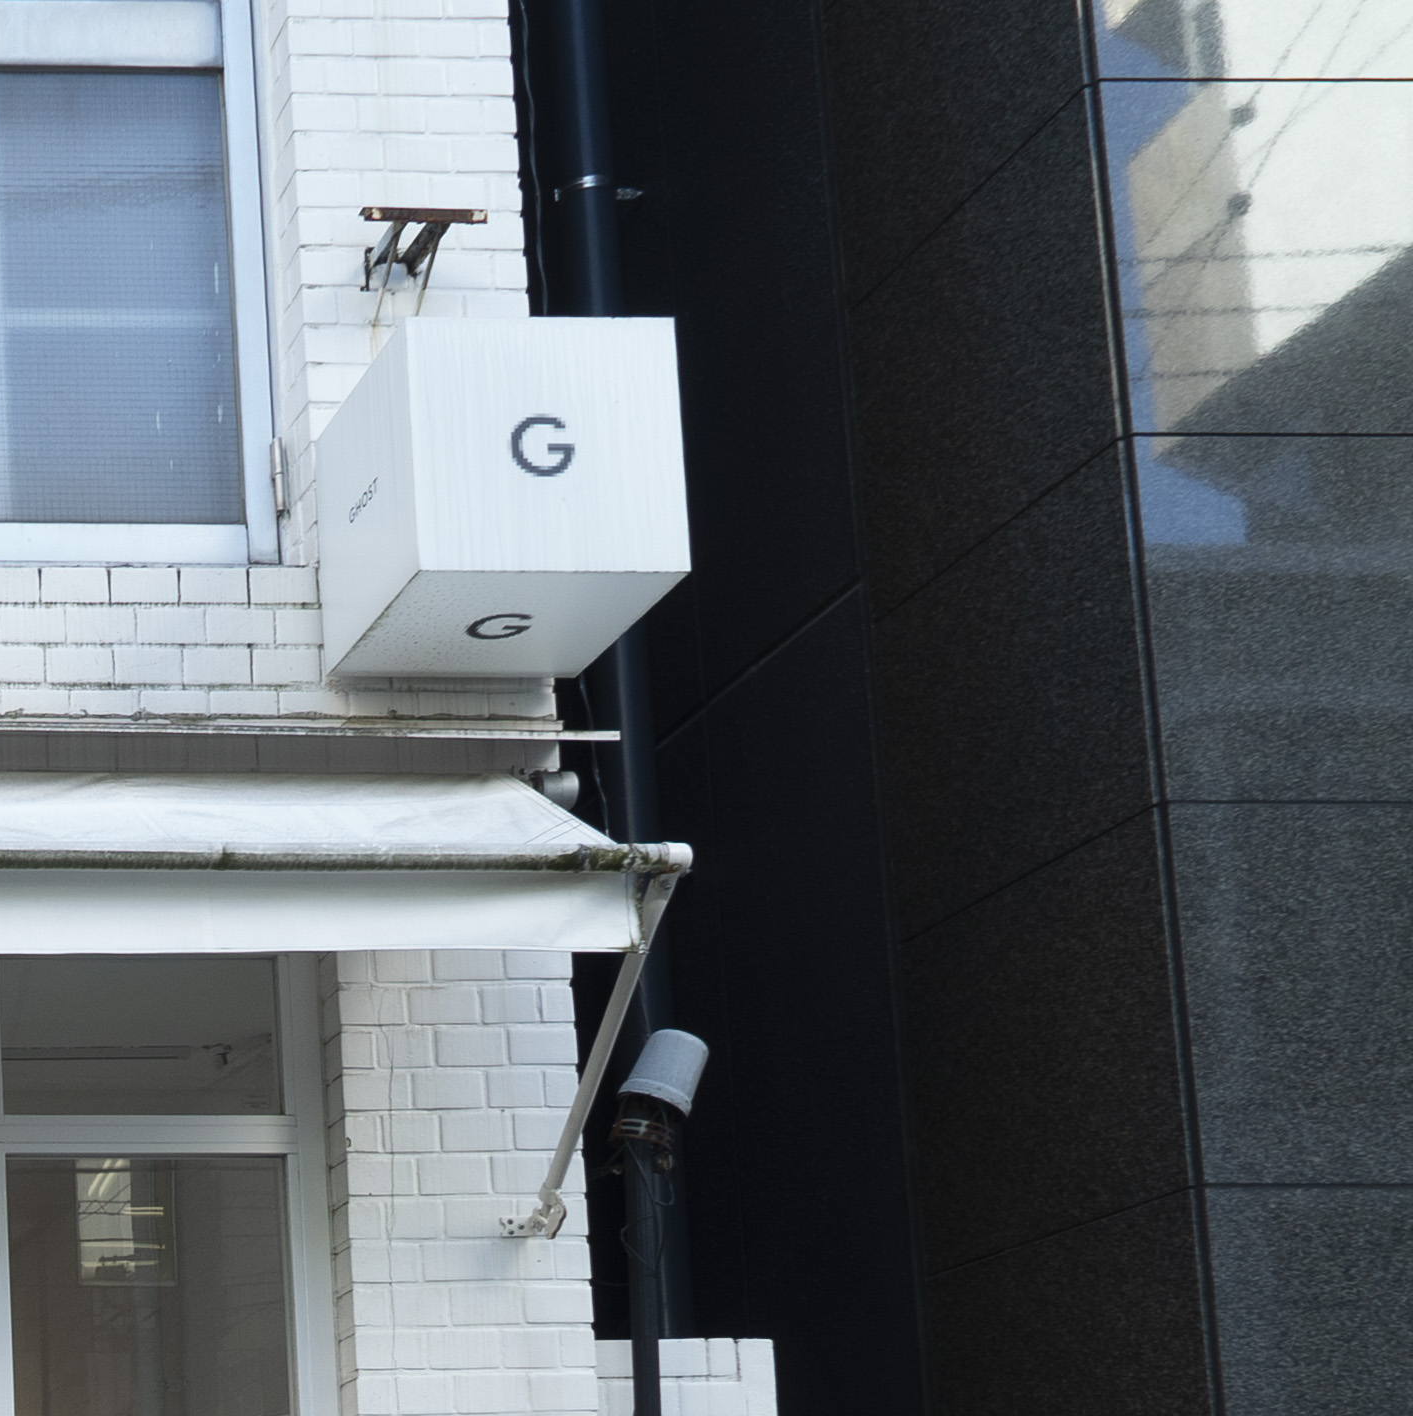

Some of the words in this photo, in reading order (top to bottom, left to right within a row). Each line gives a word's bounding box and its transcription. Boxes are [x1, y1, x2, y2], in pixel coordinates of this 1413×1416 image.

[509, 413, 575, 477] G
[348, 476, 378, 524] GHOST
[465, 613, 534, 641] G
